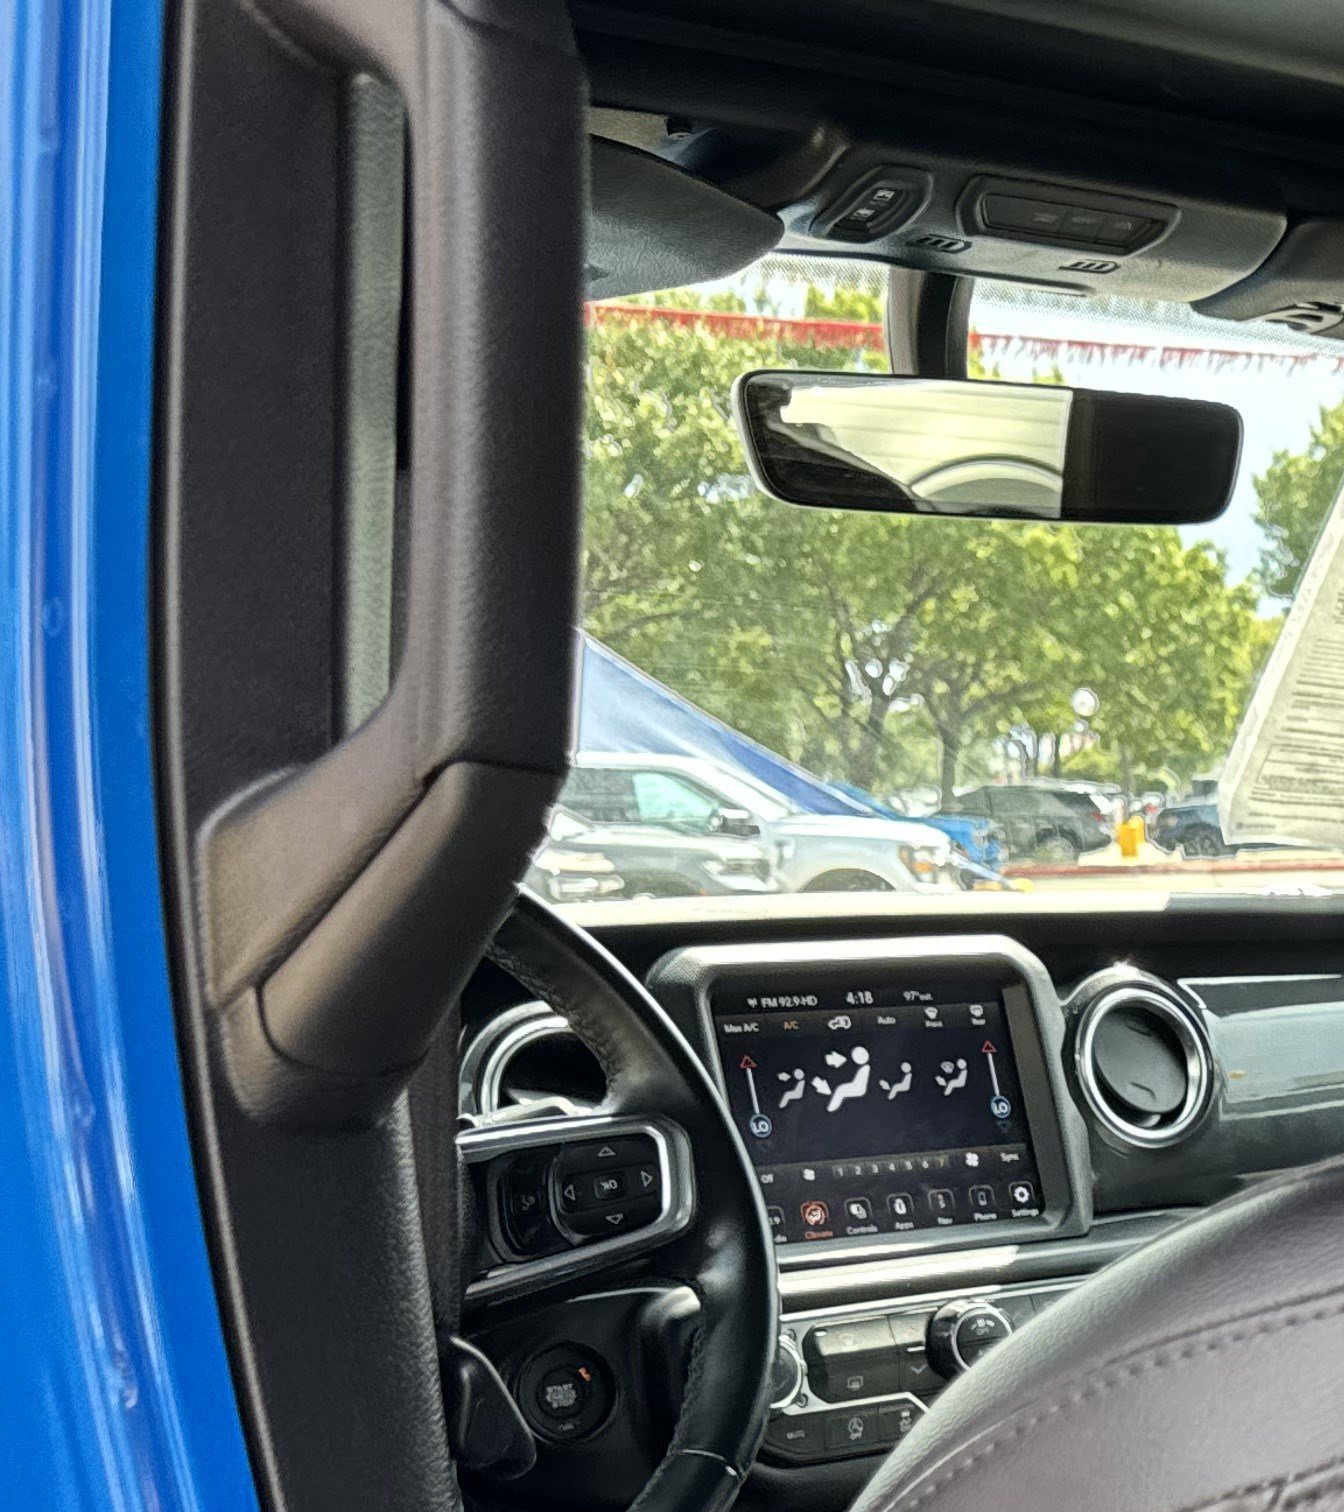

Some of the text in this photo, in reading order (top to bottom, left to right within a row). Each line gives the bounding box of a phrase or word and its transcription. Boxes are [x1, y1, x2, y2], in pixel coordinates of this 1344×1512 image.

[760, 996, 778, 1009] FM
[846, 991, 873, 1005] 4:18
[783, 1020, 799, 1030] A/C
[877, 1016, 896, 1025] Auto
[972, 1212, 998, 1222] Phone
[1011, 1207, 1040, 1219] Settings
